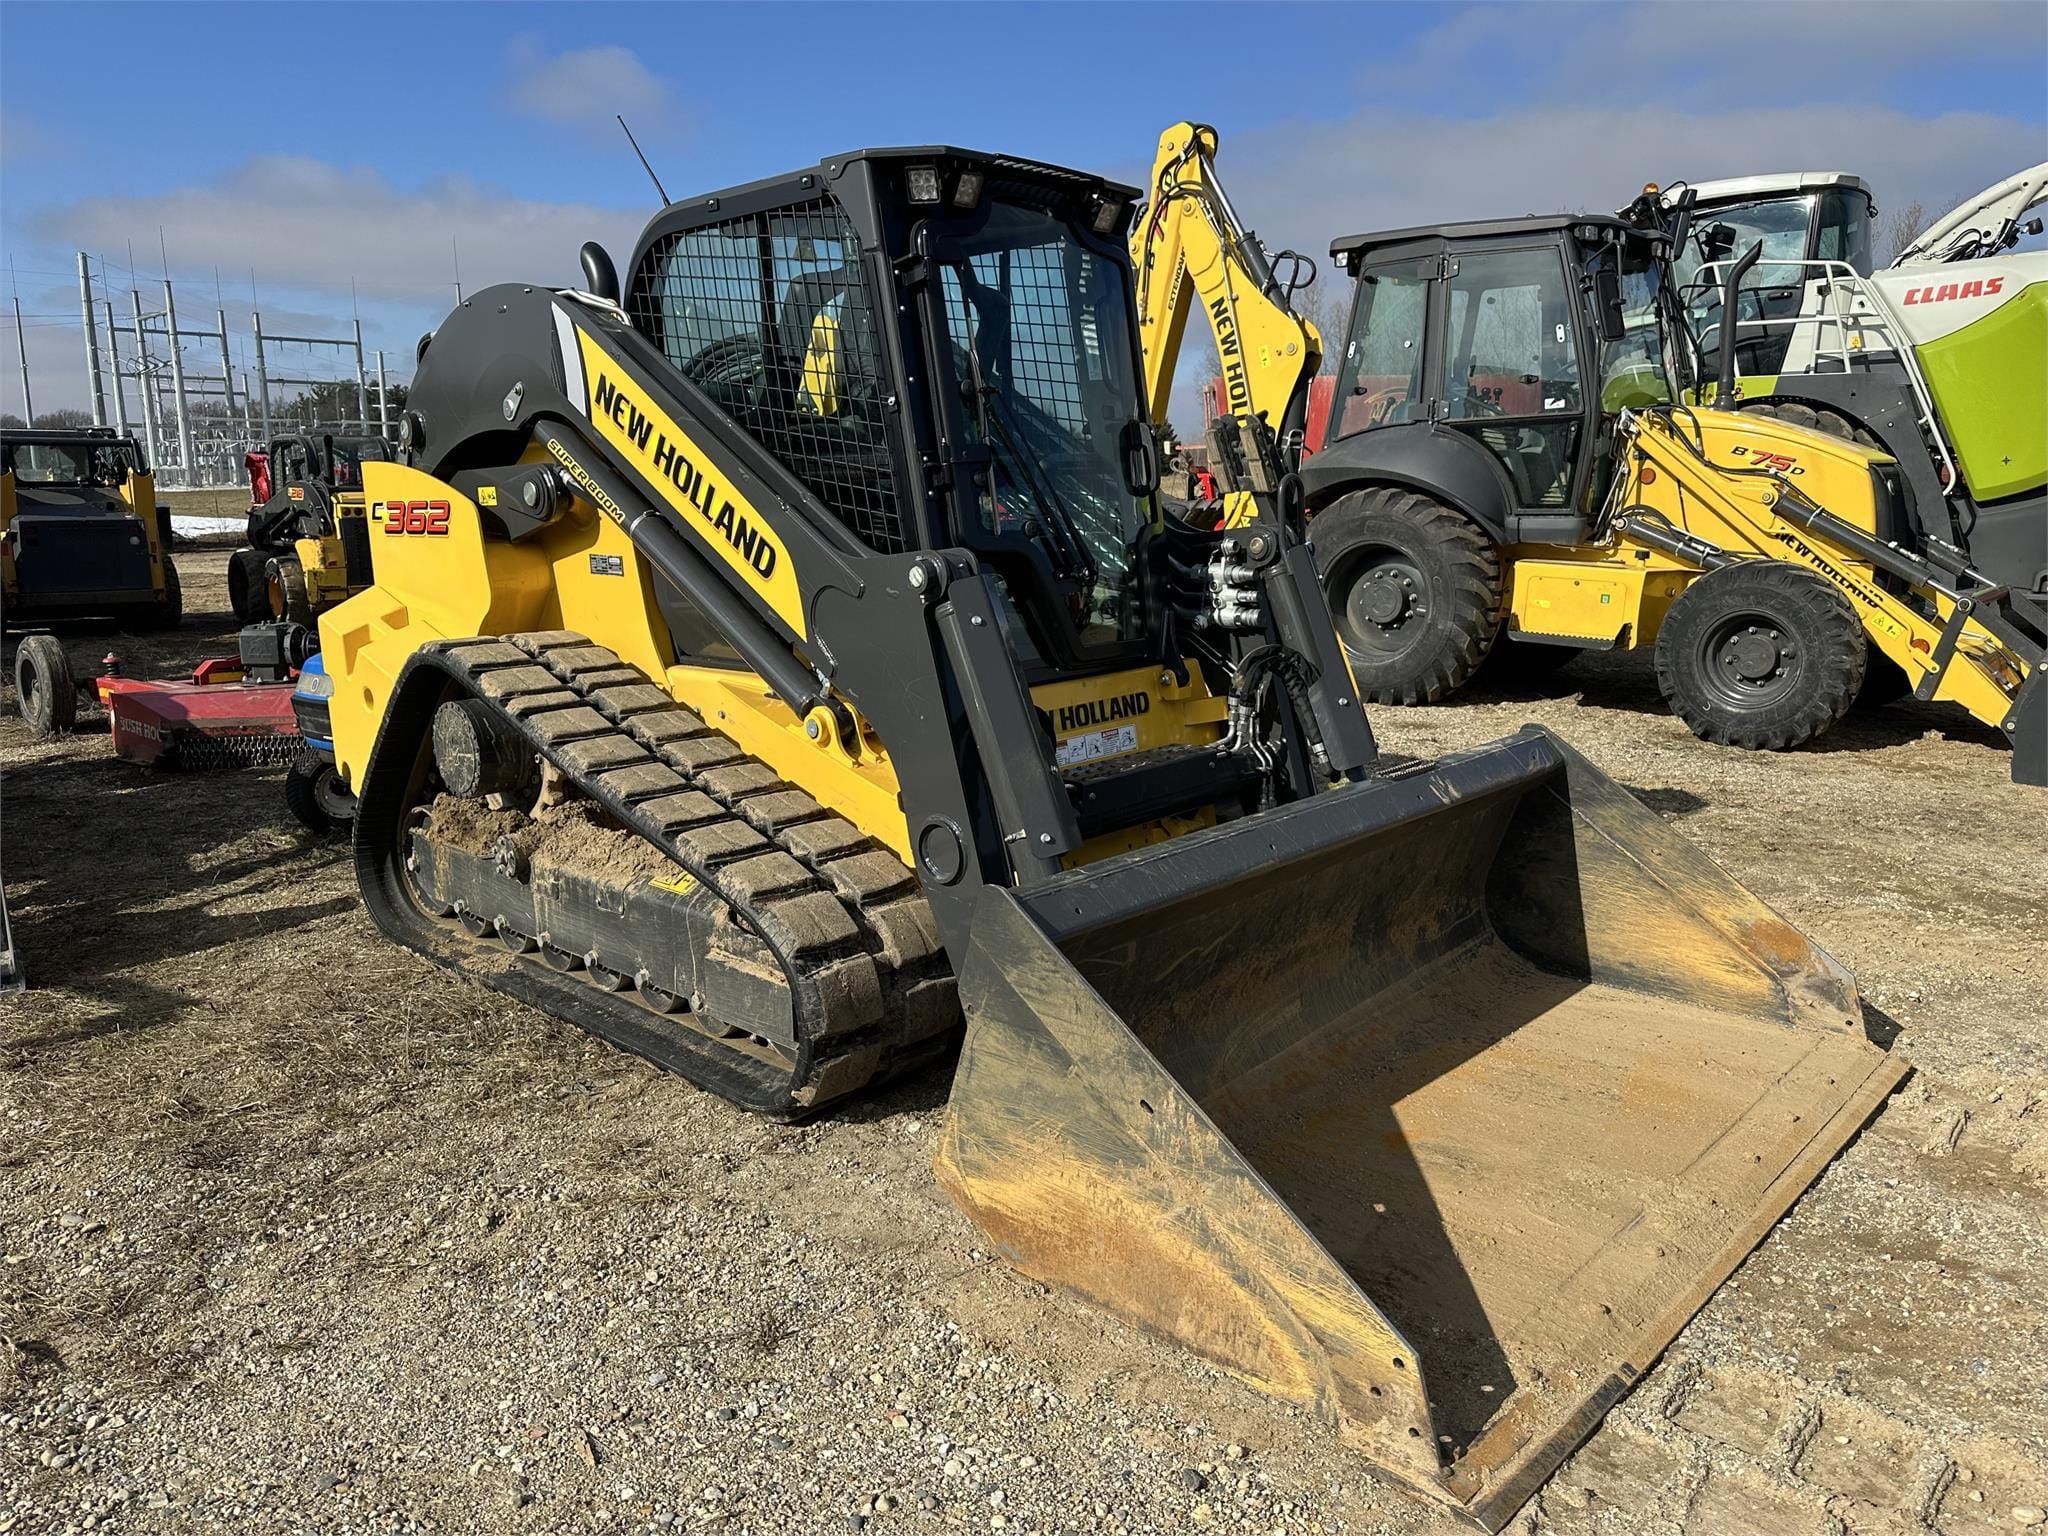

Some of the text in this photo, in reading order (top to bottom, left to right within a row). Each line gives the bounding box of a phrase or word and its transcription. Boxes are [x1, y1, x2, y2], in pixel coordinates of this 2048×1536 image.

[1903, 276, 2005, 306] CLAAS
[1210, 296, 1240, 357] NEW
[547, 438, 589, 485] SUPER
[585, 480, 626, 523] BOOM
[594, 372, 777, 581] NEW HOLLAND
[1059, 691, 1150, 731] HOLLAND
